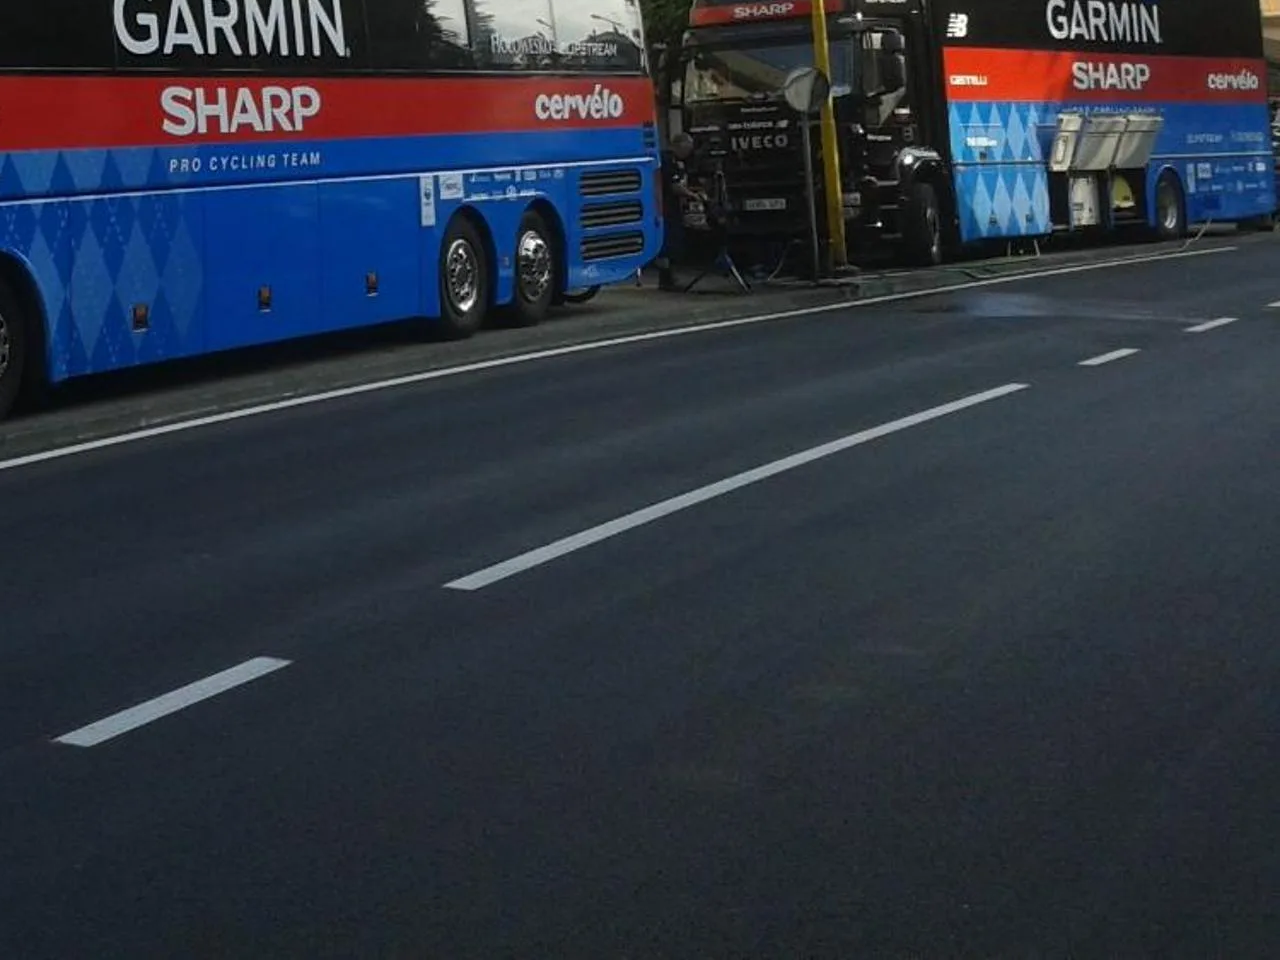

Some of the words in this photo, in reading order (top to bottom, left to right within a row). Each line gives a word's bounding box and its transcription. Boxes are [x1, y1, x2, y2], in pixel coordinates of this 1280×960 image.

[733, 2, 794, 19] SHARP
[1072, 62, 1150, 89] SHARP
[1207, 69, 1259, 89] cervélo
[160, 86, 321, 136] SHARP
[535, 84, 624, 120] cervélo
[731, 135, 789, 151] IVECO
[169, 157, 201, 173] PRO
[209, 153, 276, 171] CYCLING
[282, 151, 320, 166] TEAM
